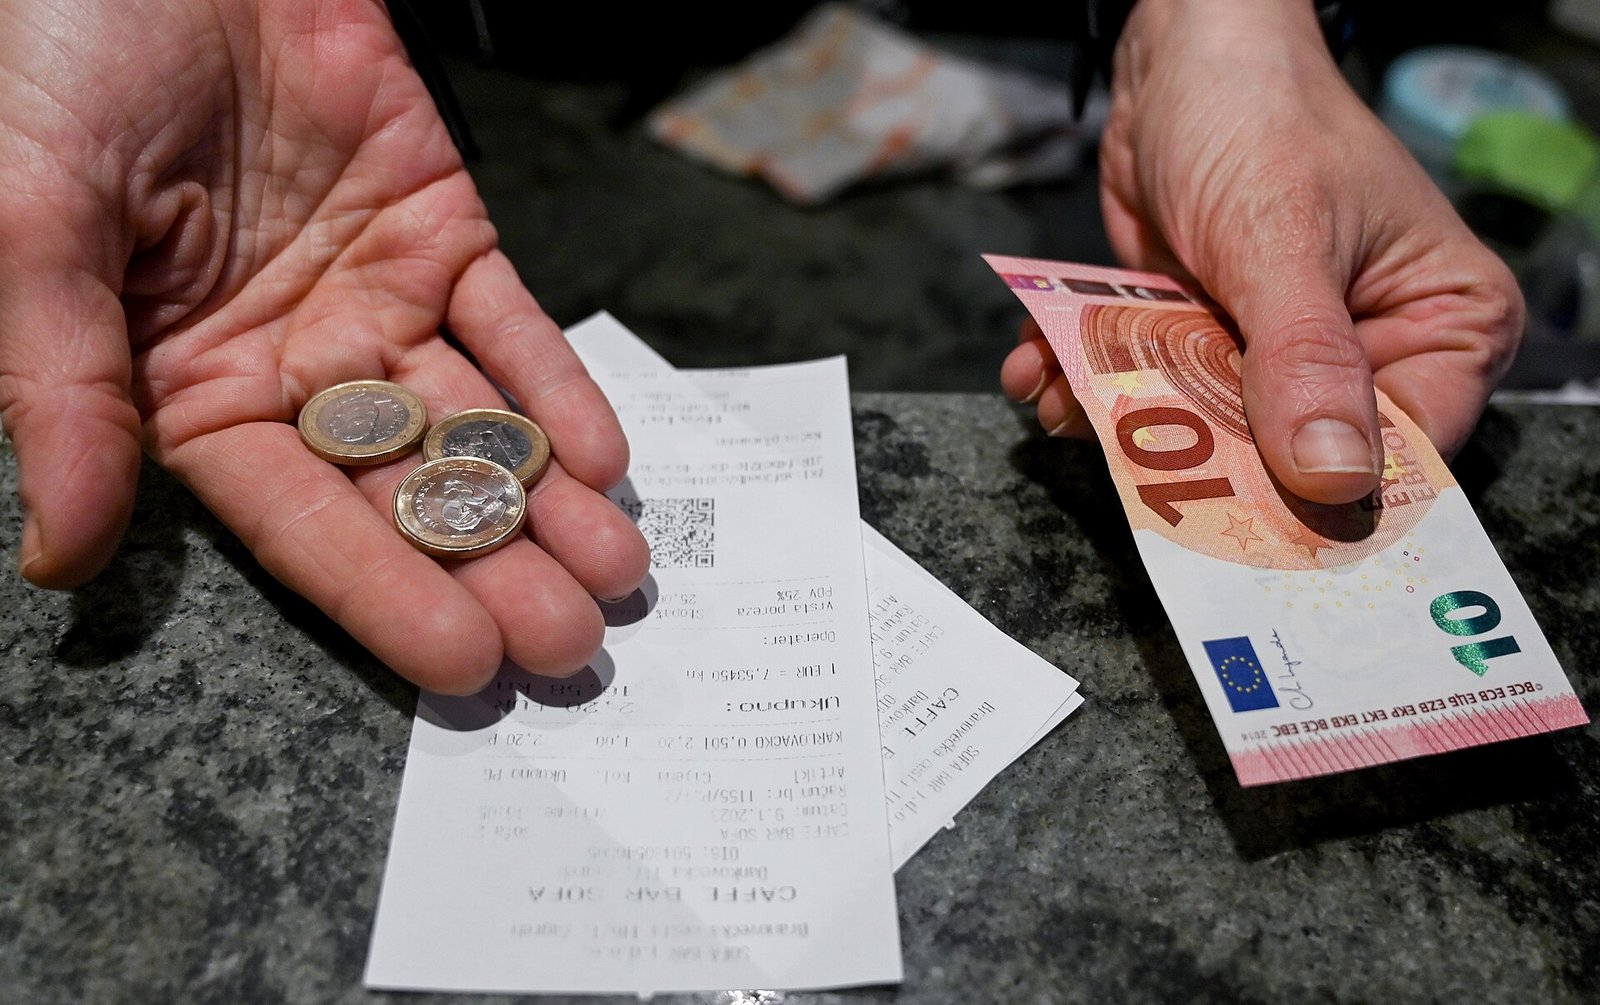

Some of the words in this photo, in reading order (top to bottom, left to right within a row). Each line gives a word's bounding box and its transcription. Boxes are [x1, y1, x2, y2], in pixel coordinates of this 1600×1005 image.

[1115, 406, 1236, 527] 10
[776, 589, 801, 602] 25%
[809, 586, 833, 599] PDV
[736, 603, 786, 617] poreza
[762, 630, 836, 647] Operater:
[1430, 590, 1521, 678] 10
[796, 664, 821, 679] EUR
[1479, 687, 1506, 701] ECB
[726, 695, 840, 713] Ukupno:
[1419, 699, 1447, 714] EZB
[1391, 705, 1417, 719] EKP
[1331, 714, 1359, 729] EKB
[1270, 723, 1299, 738] EBC
[528, 887, 593, 902] SOFA
[625, 887, 681, 902] BAR
[702, 885, 797, 902] CAFFE
